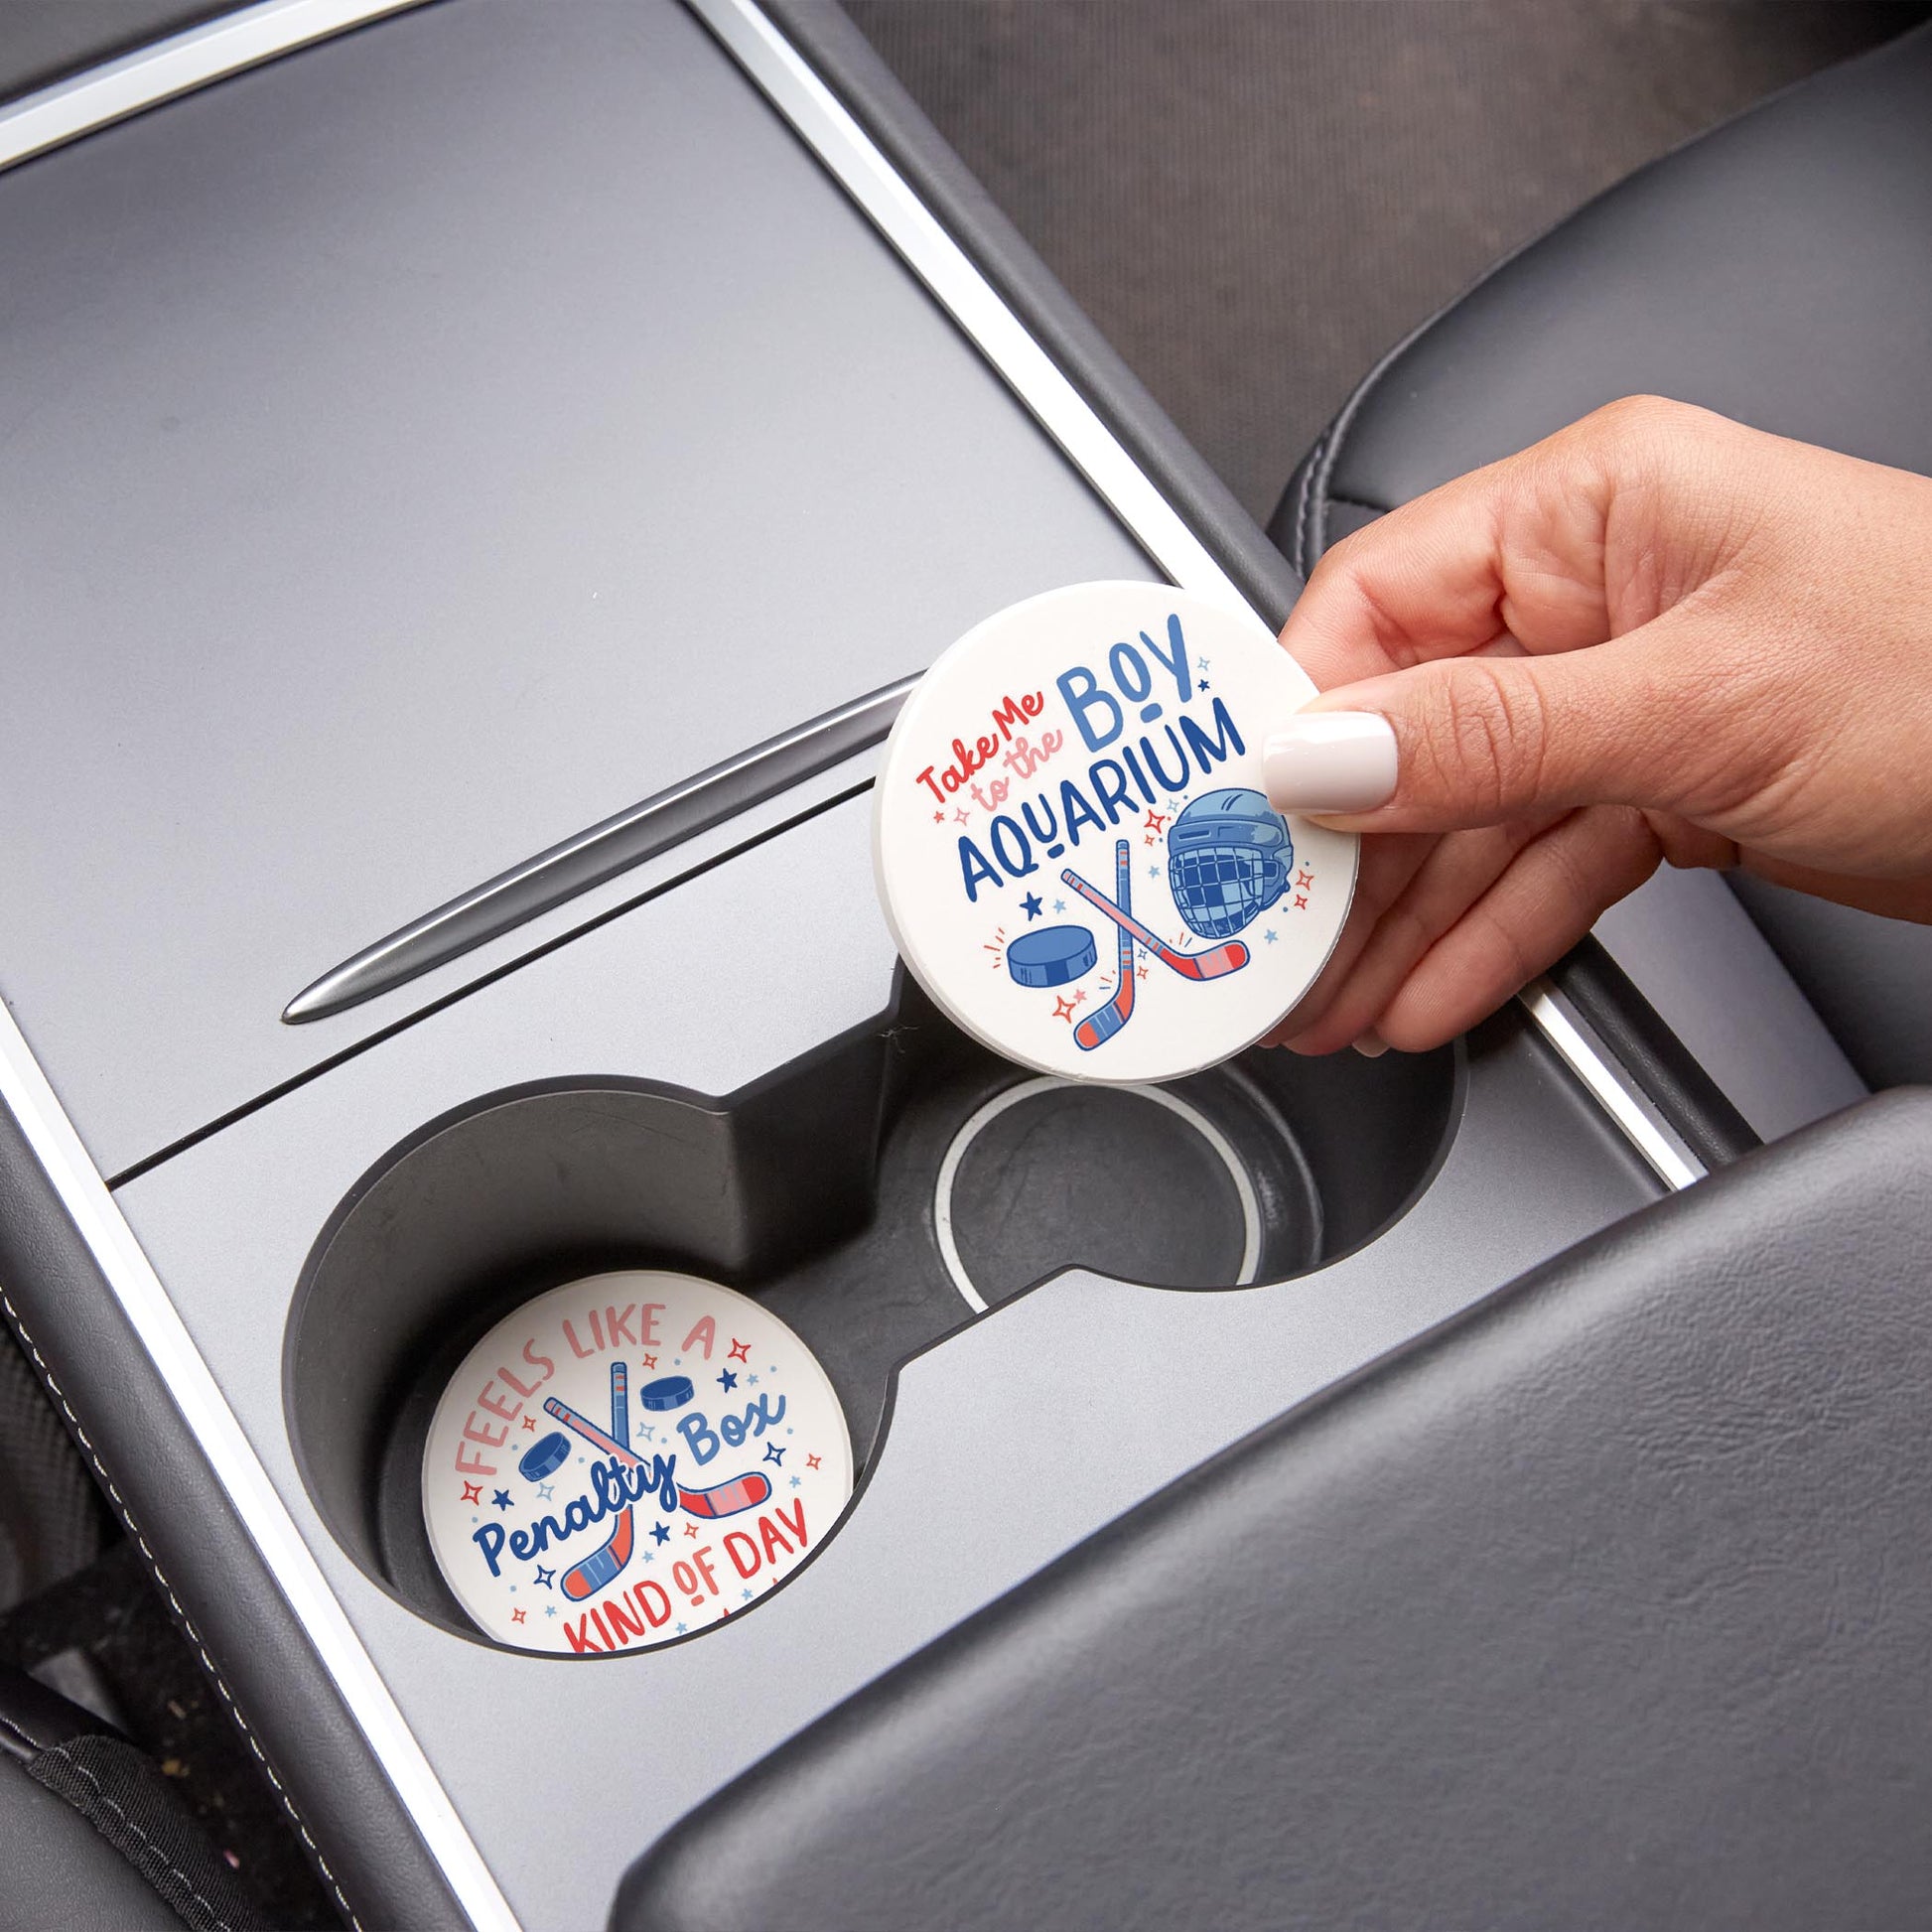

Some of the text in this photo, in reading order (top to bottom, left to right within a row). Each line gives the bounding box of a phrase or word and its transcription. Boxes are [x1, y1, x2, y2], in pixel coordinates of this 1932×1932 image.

[915, 690, 1044, 804] Take Me
[1055, 613, 1193, 754] BOY
[957, 696, 1247, 903] AQUARIUM
[970, 729, 1064, 813] to the
[455, 1303, 717, 1476] FEELS LIKE A
[472, 1392, 787, 1578] Penalty Box
[562, 1497, 809, 1655] KIND OF DAY
